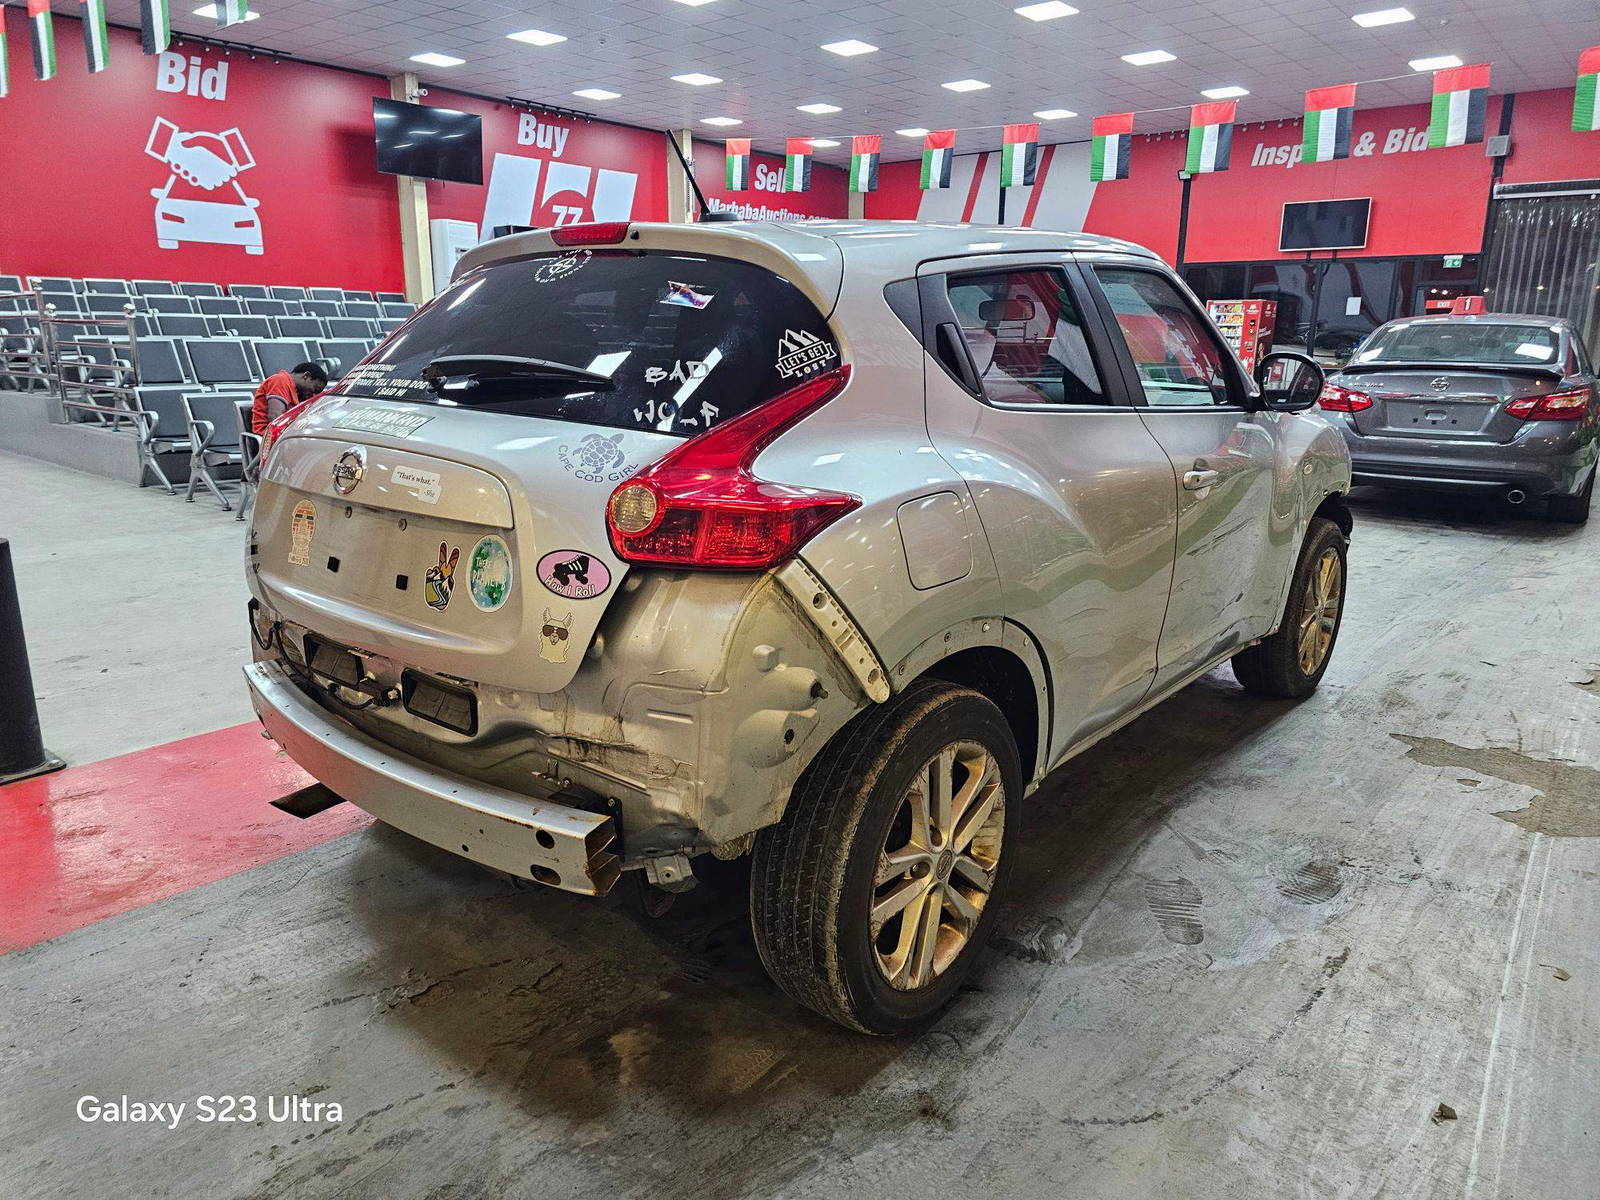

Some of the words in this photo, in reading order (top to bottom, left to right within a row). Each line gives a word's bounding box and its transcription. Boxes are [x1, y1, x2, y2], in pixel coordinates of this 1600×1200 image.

[156, 51, 229, 101] Bid
[517, 113, 570, 157] Buy
[1353, 131, 1377, 157] &
[1382, 127, 1430, 154] Bid
[754, 163, 787, 193] Sell
[552, 204, 583, 227] 77
[783, 352, 808, 369] LET'S
[807, 344, 825, 358] GET
[795, 359, 827, 377] LOST
[389, 378, 411, 388] YOUR
[408, 380, 429, 390] DOG
[644, 360, 710, 388] BAD
[378, 387, 397, 396] SAID
[558, 445, 575, 472] CAPE
[575, 469, 604, 483] COD
[608, 463, 640, 482] GIRL
[544, 574, 565, 593] How
[567, 585, 573, 596] I
[575, 584, 596, 597] Roll
